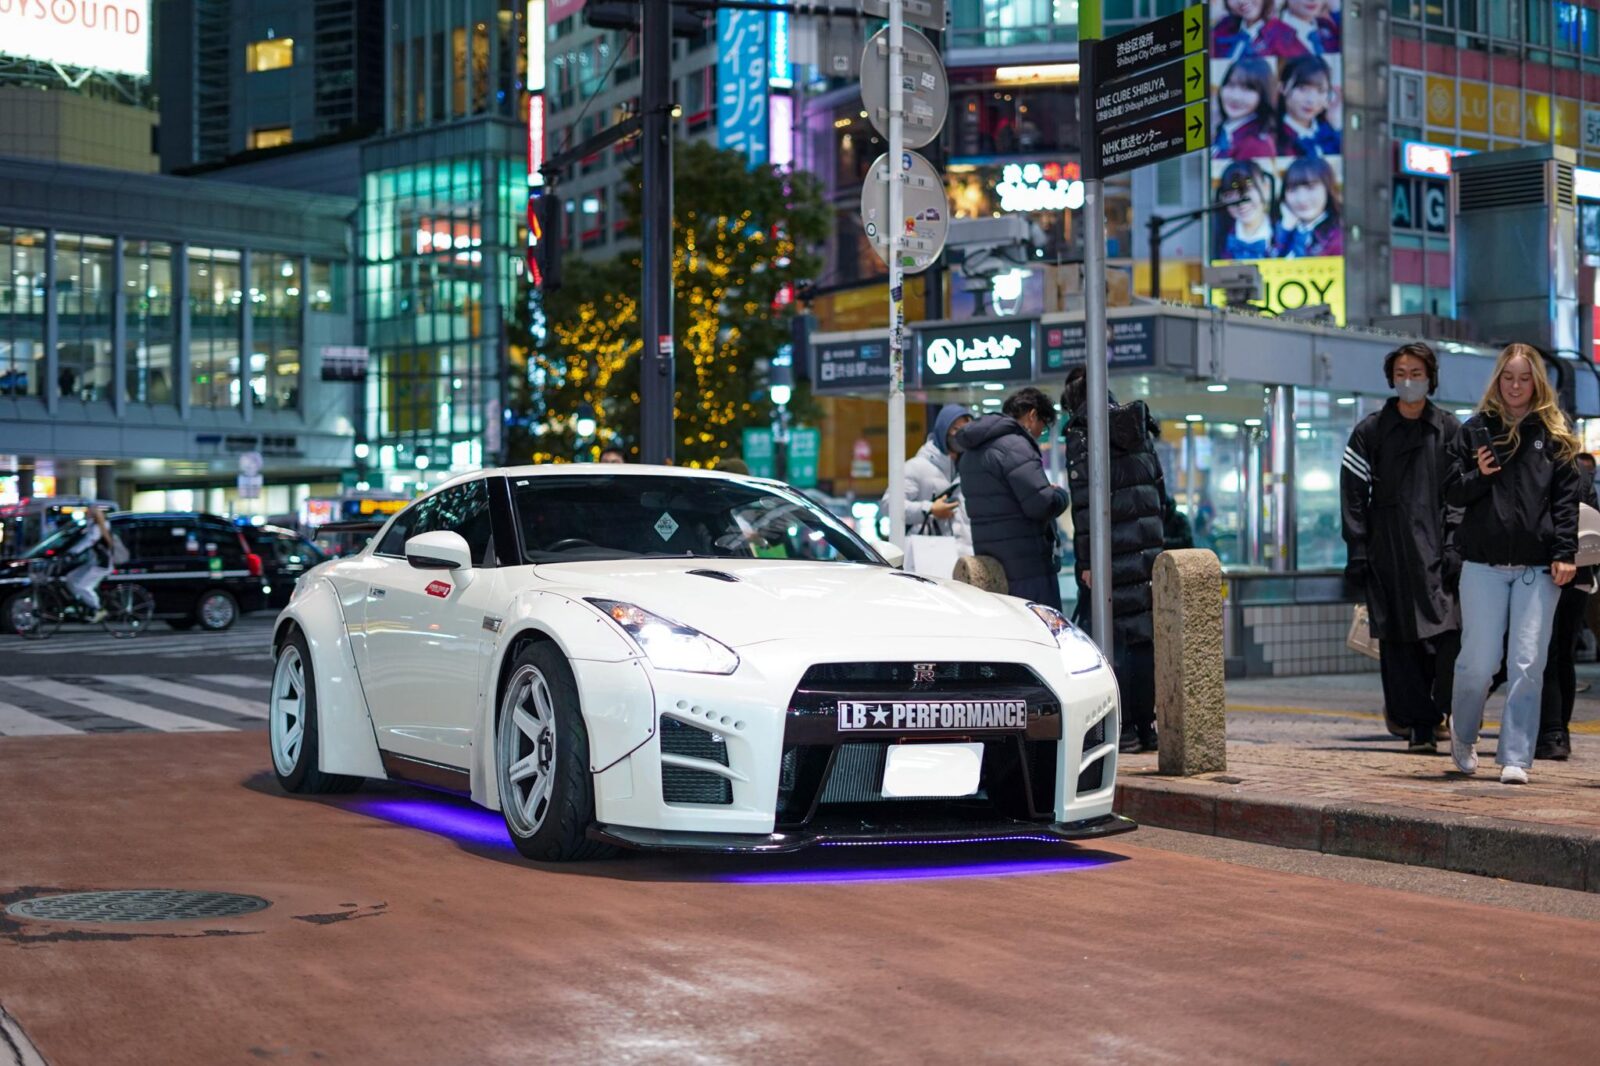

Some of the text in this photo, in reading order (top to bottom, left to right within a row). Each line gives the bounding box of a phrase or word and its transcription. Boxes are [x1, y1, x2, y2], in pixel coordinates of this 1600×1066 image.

[1117, 33, 1154, 57] 渋谷区役所
[1117, 54, 1138, 68] Shibuya
[1138, 49, 1149, 60] City
[1149, 44, 1167, 55] Office
[1096, 77, 1165, 110] LINE CUBE SHIBUYA
[1125, 97, 1144, 112] Shibuya
[1144, 93, 1159, 106] Public
[1159, 90, 1169, 101] Hall
[1102, 155, 1115, 167] NHK
[1115, 147, 1150, 163] Broadcasting
[1150, 140, 1168, 152] Center
[841, 702, 1025, 729] LB PERFORMANCE
